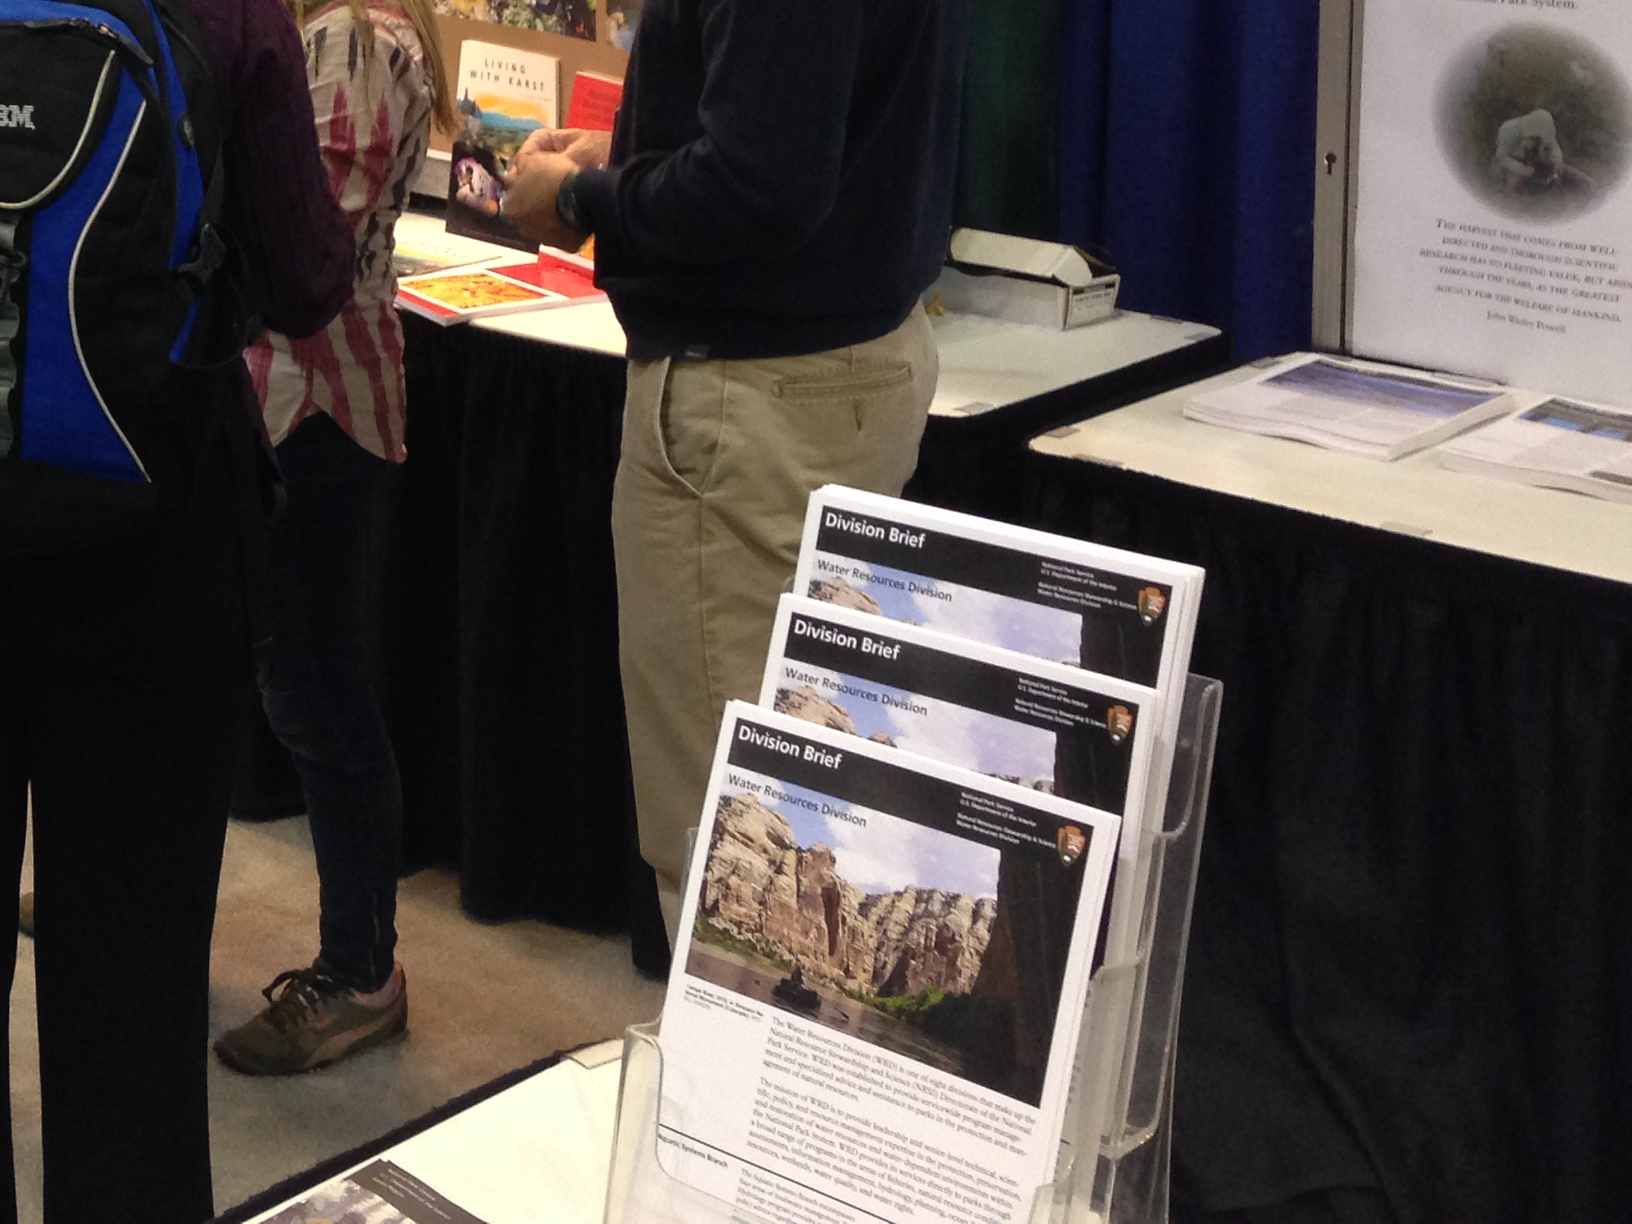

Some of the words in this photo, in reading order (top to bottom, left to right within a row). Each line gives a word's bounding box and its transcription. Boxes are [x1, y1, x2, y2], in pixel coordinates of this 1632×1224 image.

[470, 68, 501, 82] WITH
[507, 75, 545, 91] KARST
[484, 58, 526, 74] LIVING
[825, 511, 885, 543] Division
[888, 526, 926, 550] Brief
[816, 558, 852, 579] Water
[853, 567, 906, 592] Resources
[906, 579, 953, 603] Division
[794, 619, 857, 651] Division
[861, 634, 901, 663] Brief
[785, 666, 821, 687] Water
[823, 675, 878, 703] Resources
[881, 690, 928, 717] Division
[738, 724, 801, 758] Division
[804, 743, 843, 771] Brief
[728, 772, 763, 794] Water
[763, 782, 818, 811] Resources
[821, 800, 867, 828] Division
